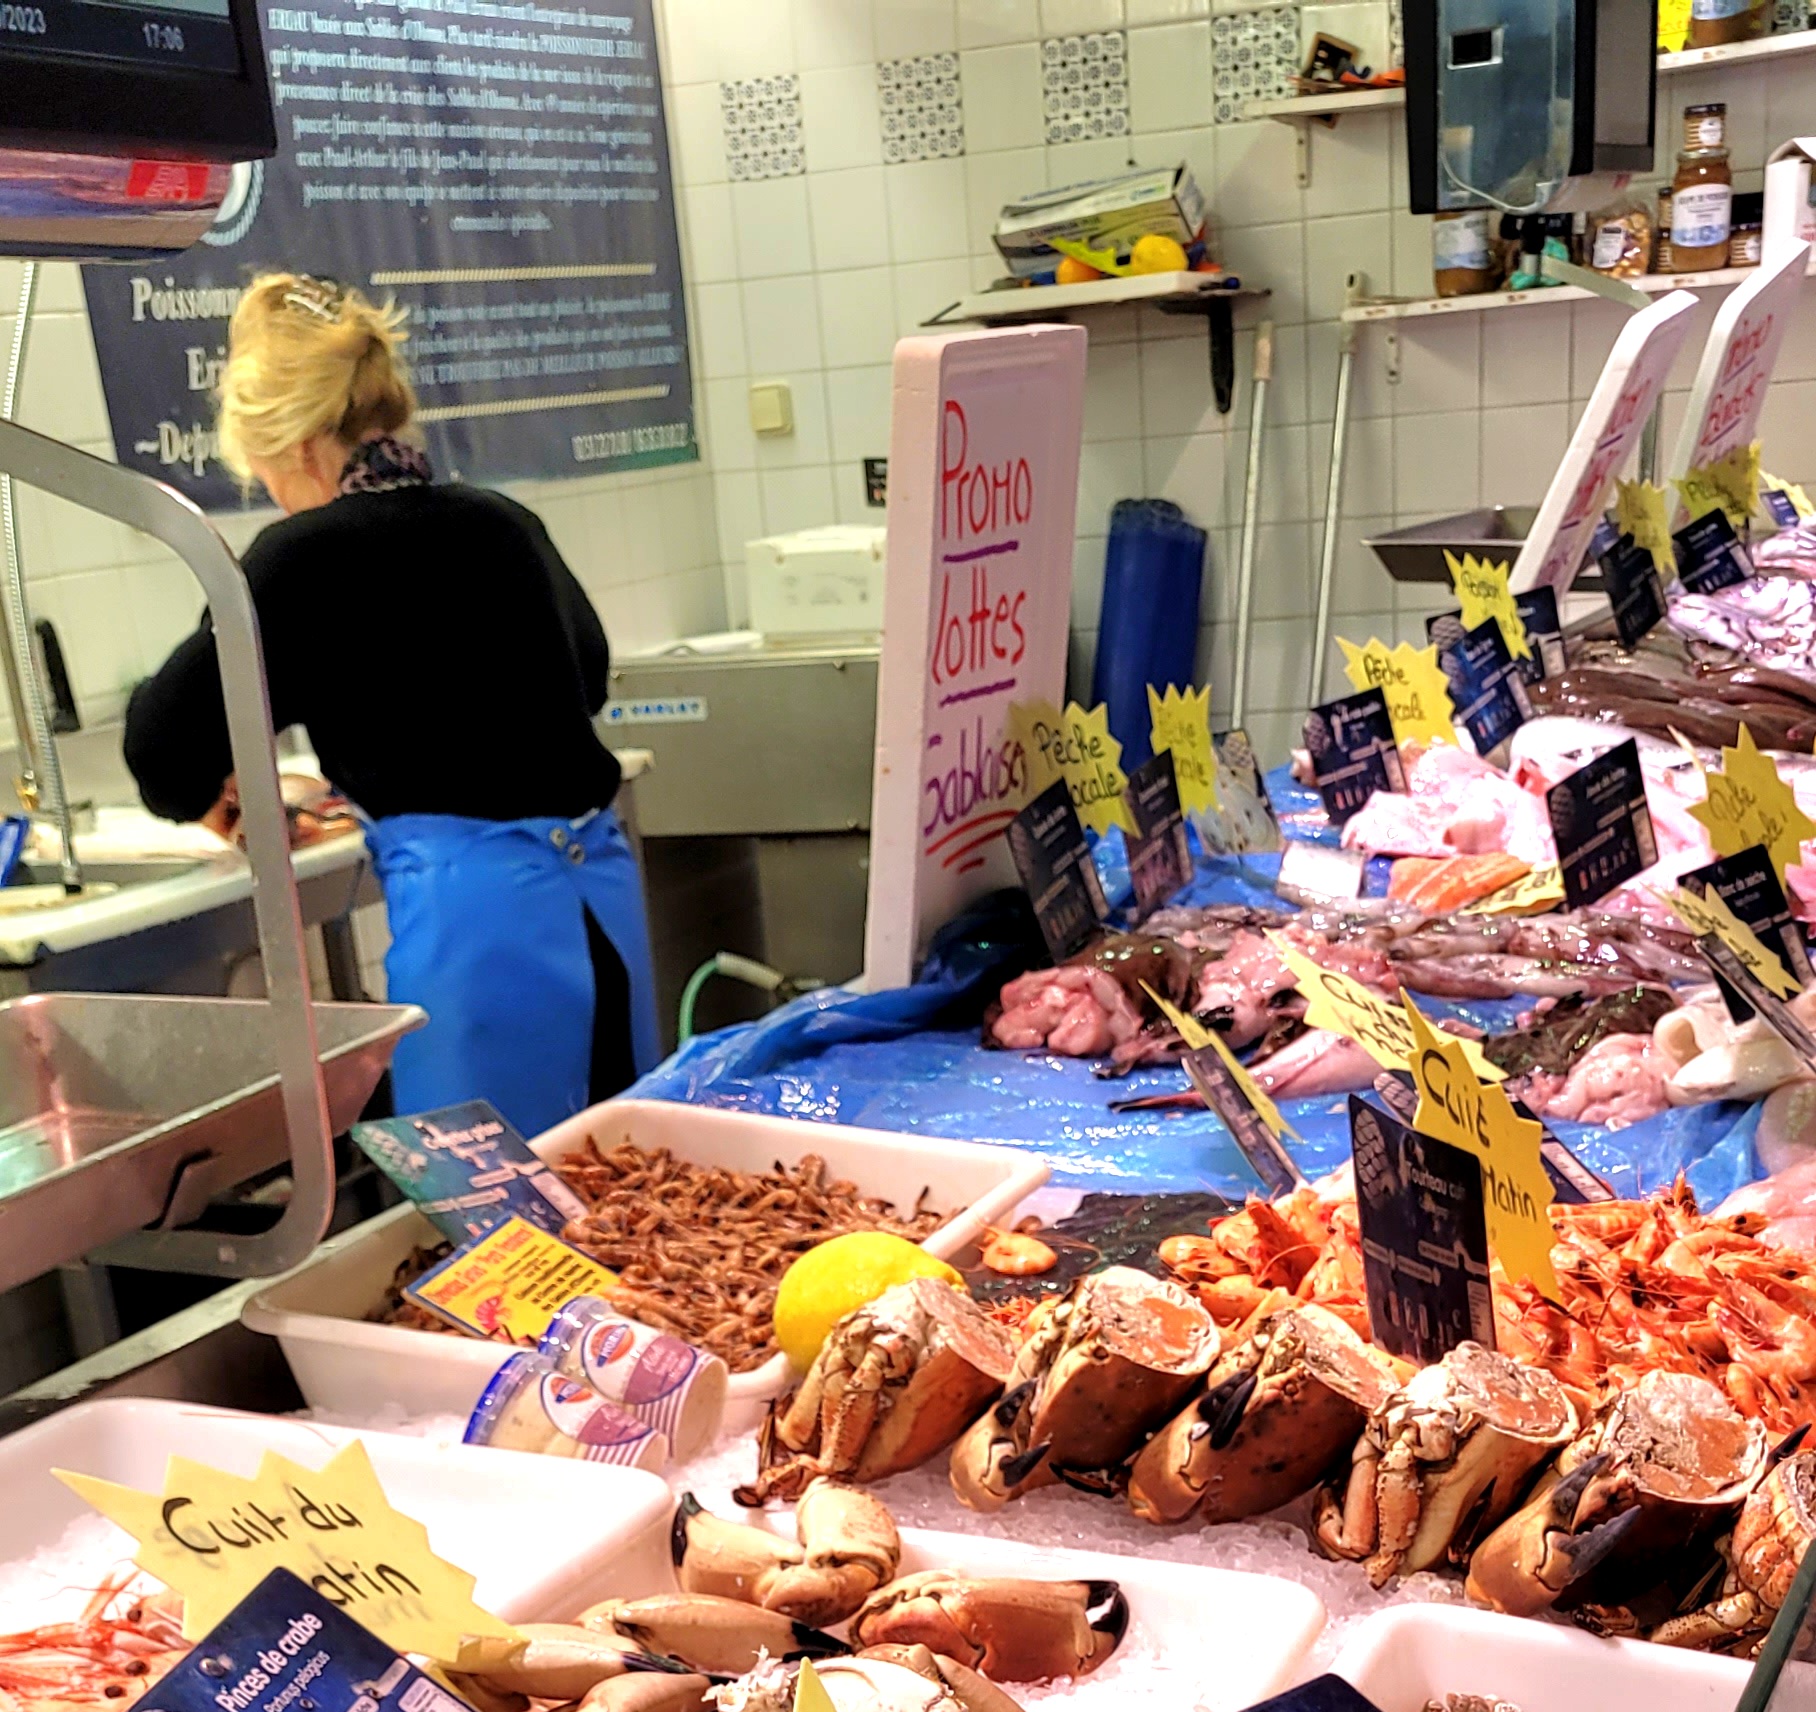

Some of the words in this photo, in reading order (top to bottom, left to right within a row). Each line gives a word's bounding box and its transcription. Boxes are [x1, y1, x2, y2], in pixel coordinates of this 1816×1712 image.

[142, 22, 185, 51] 17:06
[129, 276, 241, 321] Poissonn
[1070, 762, 1121, 807] ocale
[162, 1496, 288, 1554] Cuit
[292, 1487, 364, 1531] du
[311, 1559, 421, 1605] atin
[256, 1650, 288, 1675] de
[278, 1612, 323, 1657] crabe
